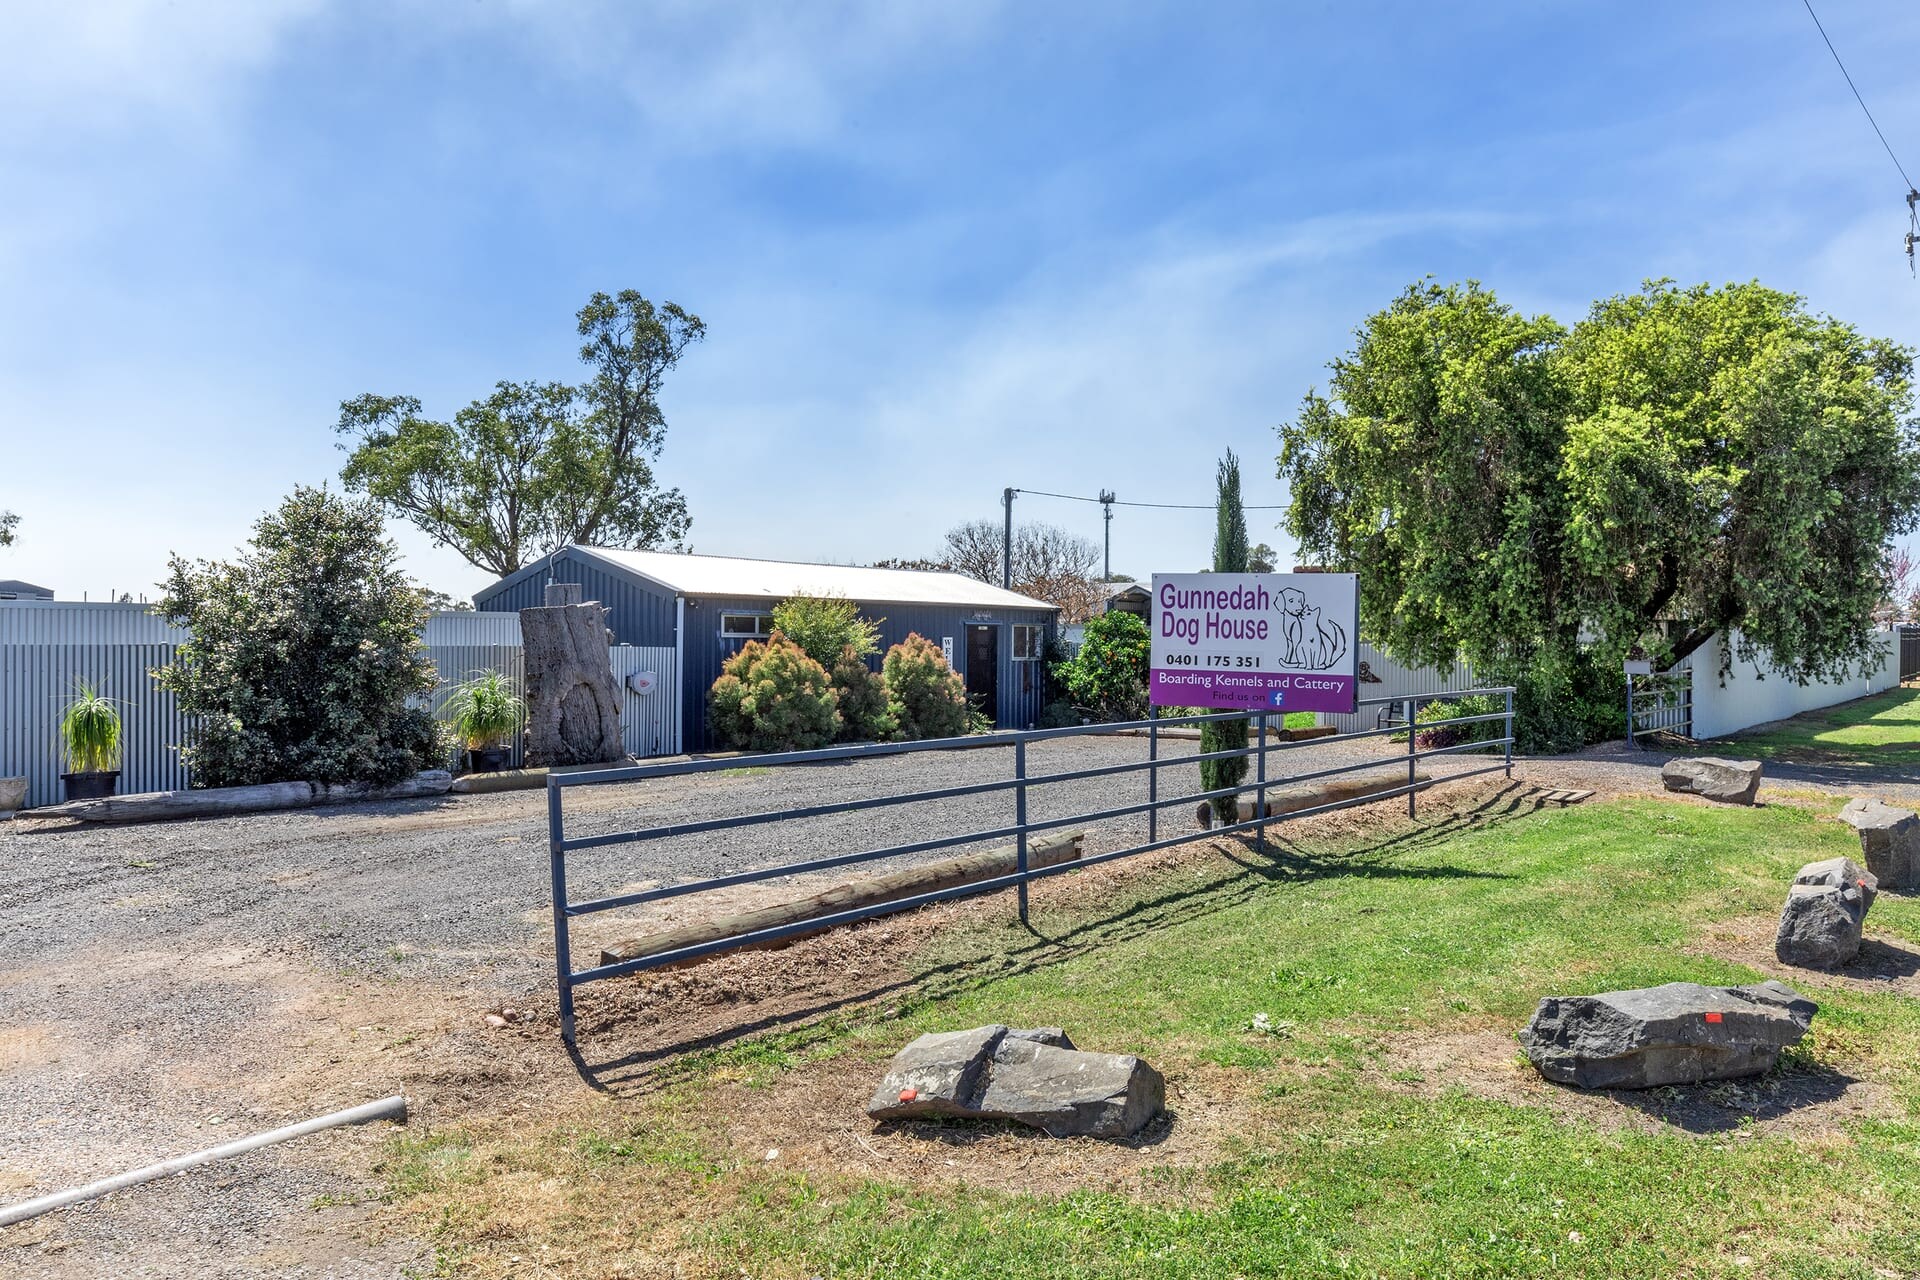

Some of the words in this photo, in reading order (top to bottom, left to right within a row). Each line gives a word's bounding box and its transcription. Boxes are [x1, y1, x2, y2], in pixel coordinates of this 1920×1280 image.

[1160, 583, 1269, 610] Gunnedah
[1162, 611, 1199, 645] Dog
[1206, 612, 1268, 640] House
[1166, 654, 1198, 666] 0401
[1207, 655, 1230, 667] 175
[1236, 657, 1260, 668] 351
[1159, 672, 1212, 688] Boarding
[1215, 674, 1263, 687] Kennels
[1267, 677, 1290, 689] and
[1294, 677, 1344, 694] Cattery
[1213, 691, 1234, 701] Find
